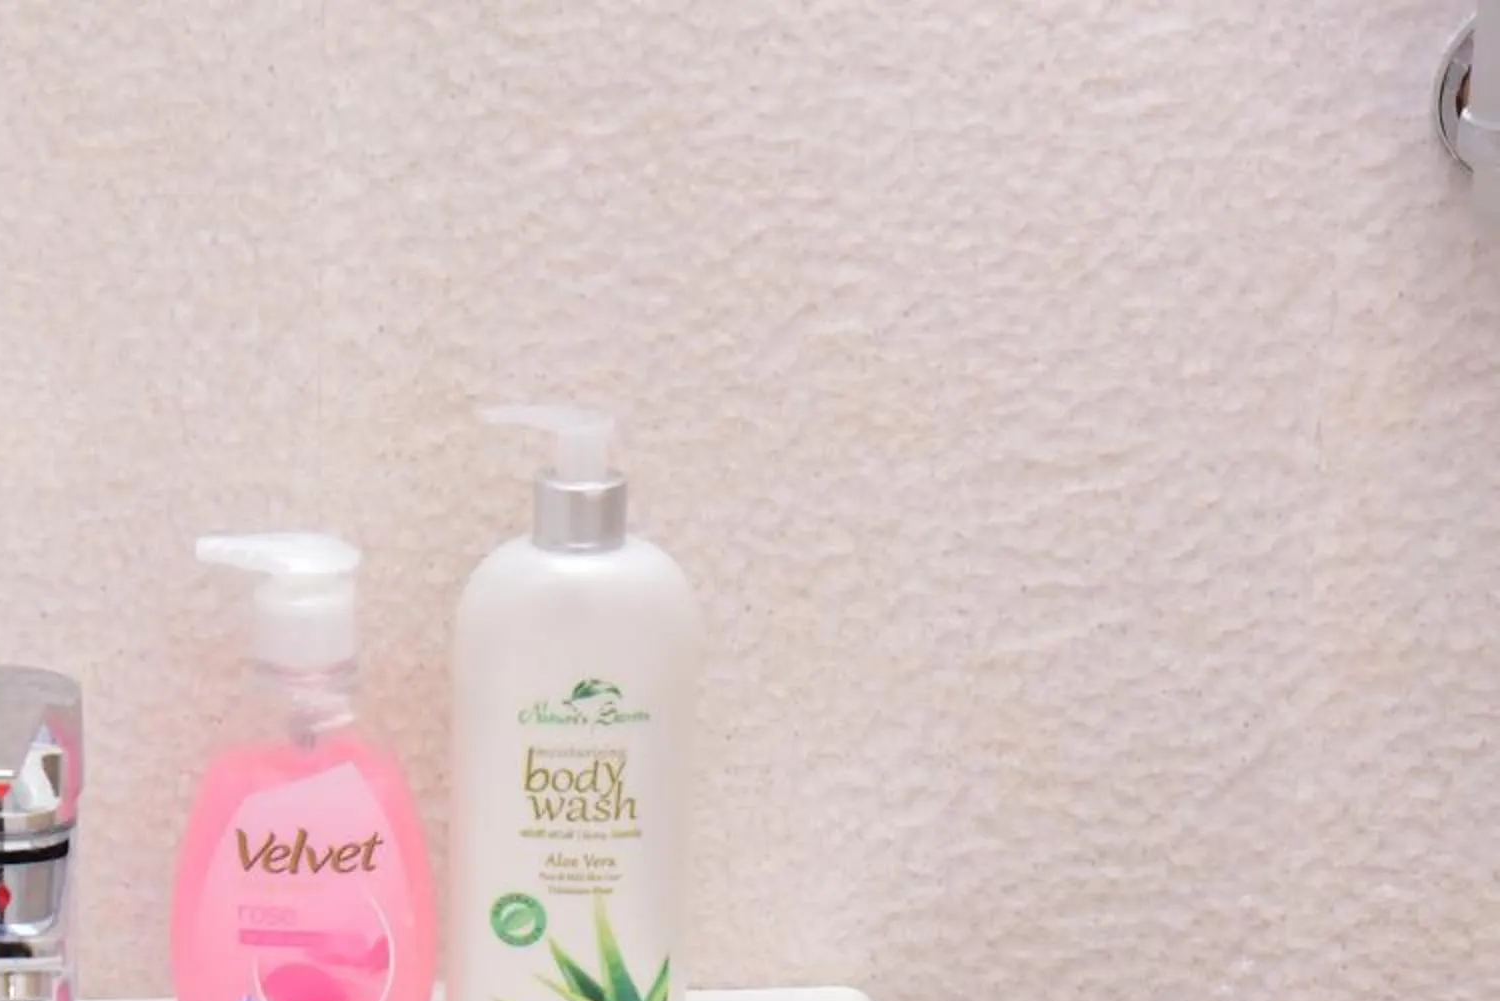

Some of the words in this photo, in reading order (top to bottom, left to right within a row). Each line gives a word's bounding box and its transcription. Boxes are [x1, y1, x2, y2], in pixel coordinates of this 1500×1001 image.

[524, 747, 627, 797] body
[526, 780, 637, 822] wash
[235, 827, 384, 875] Velvet
[545, 852, 579, 868] Aloe
[584, 853, 616, 868] Vera
